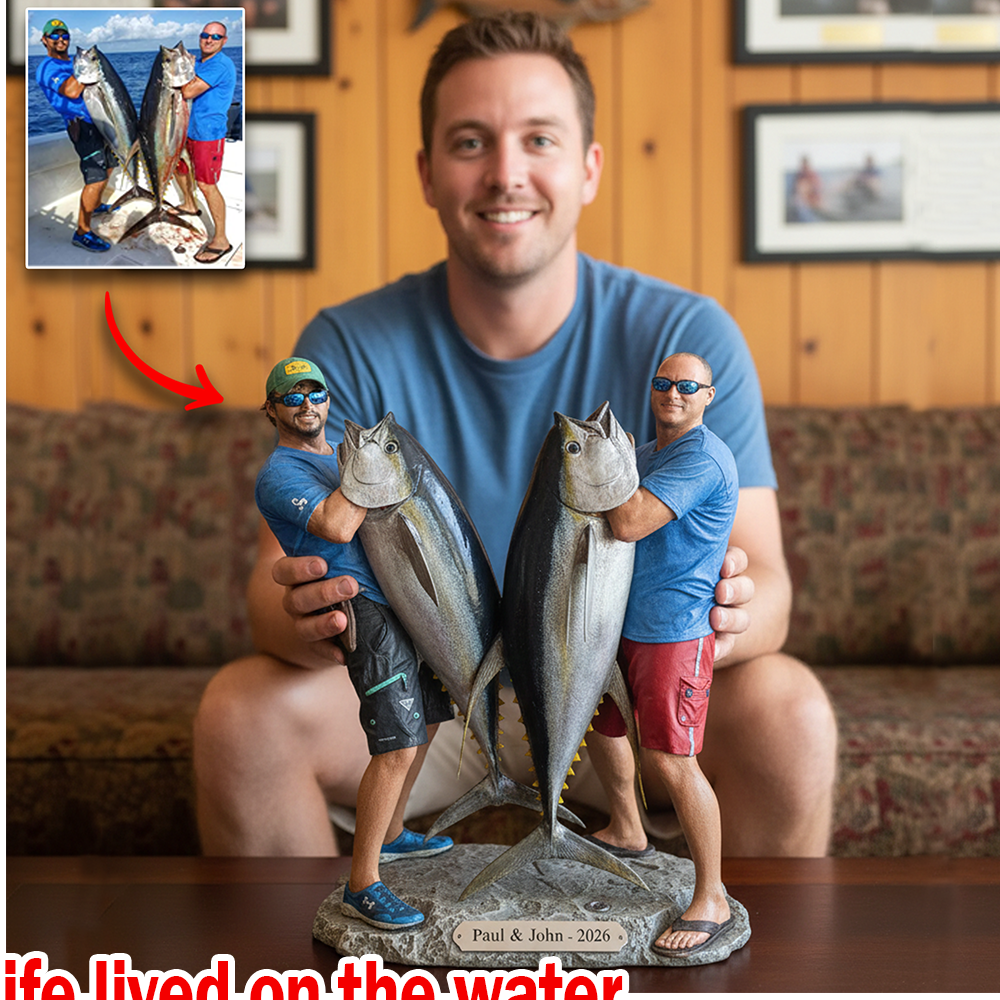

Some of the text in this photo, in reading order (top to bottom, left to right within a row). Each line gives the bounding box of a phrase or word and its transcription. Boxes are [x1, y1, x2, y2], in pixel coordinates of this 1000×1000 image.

[472, 928, 504, 942] Paul
[510, 928, 523, 942] &
[529, 928, 563, 942] John
[577, 928, 611, 942] 2026
